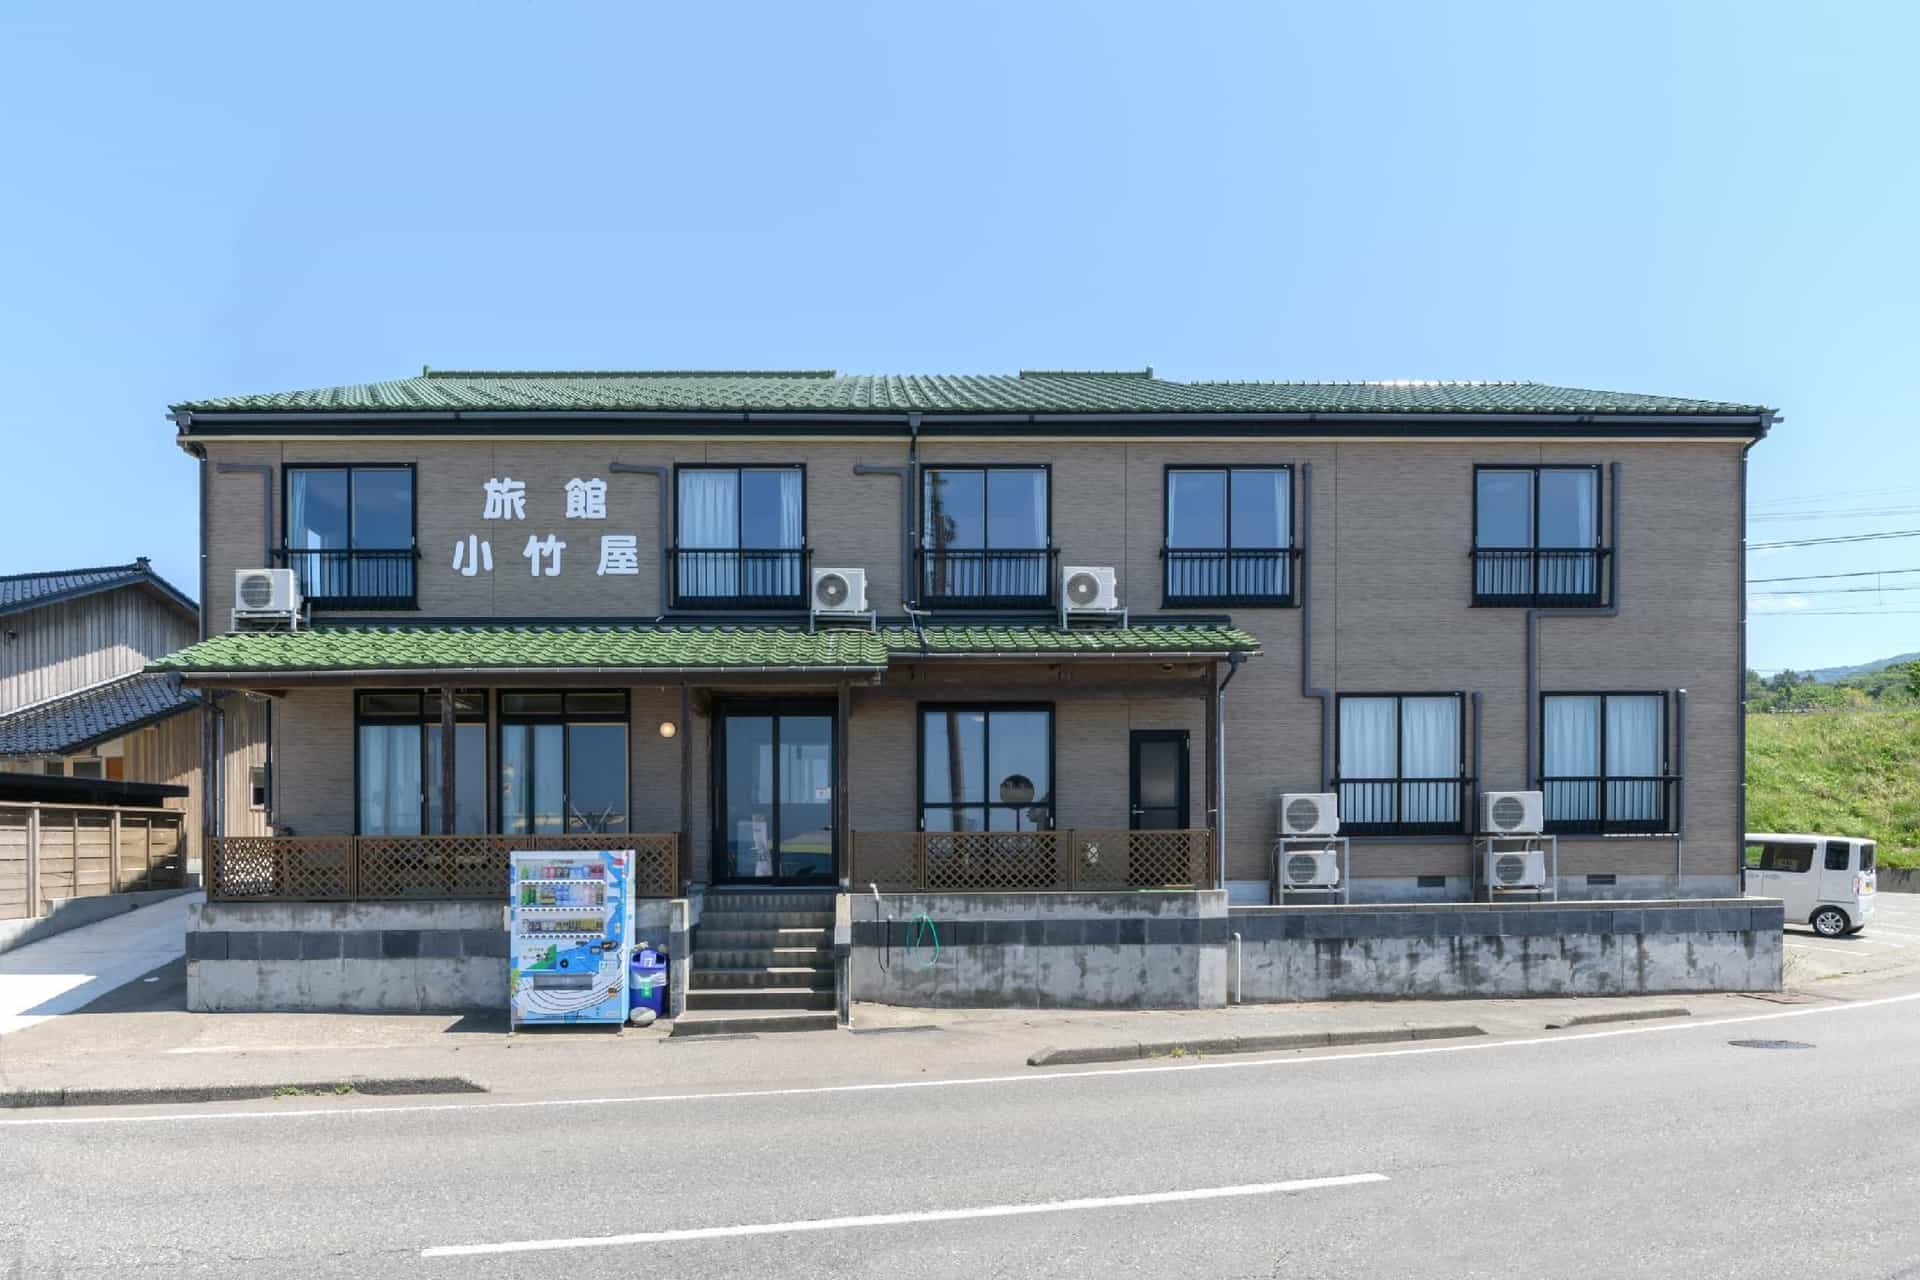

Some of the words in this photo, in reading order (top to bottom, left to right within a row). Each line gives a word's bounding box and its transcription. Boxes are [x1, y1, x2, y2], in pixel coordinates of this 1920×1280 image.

[483, 477, 607, 520] 旅館
[452, 533, 640, 577] 小竹屋
